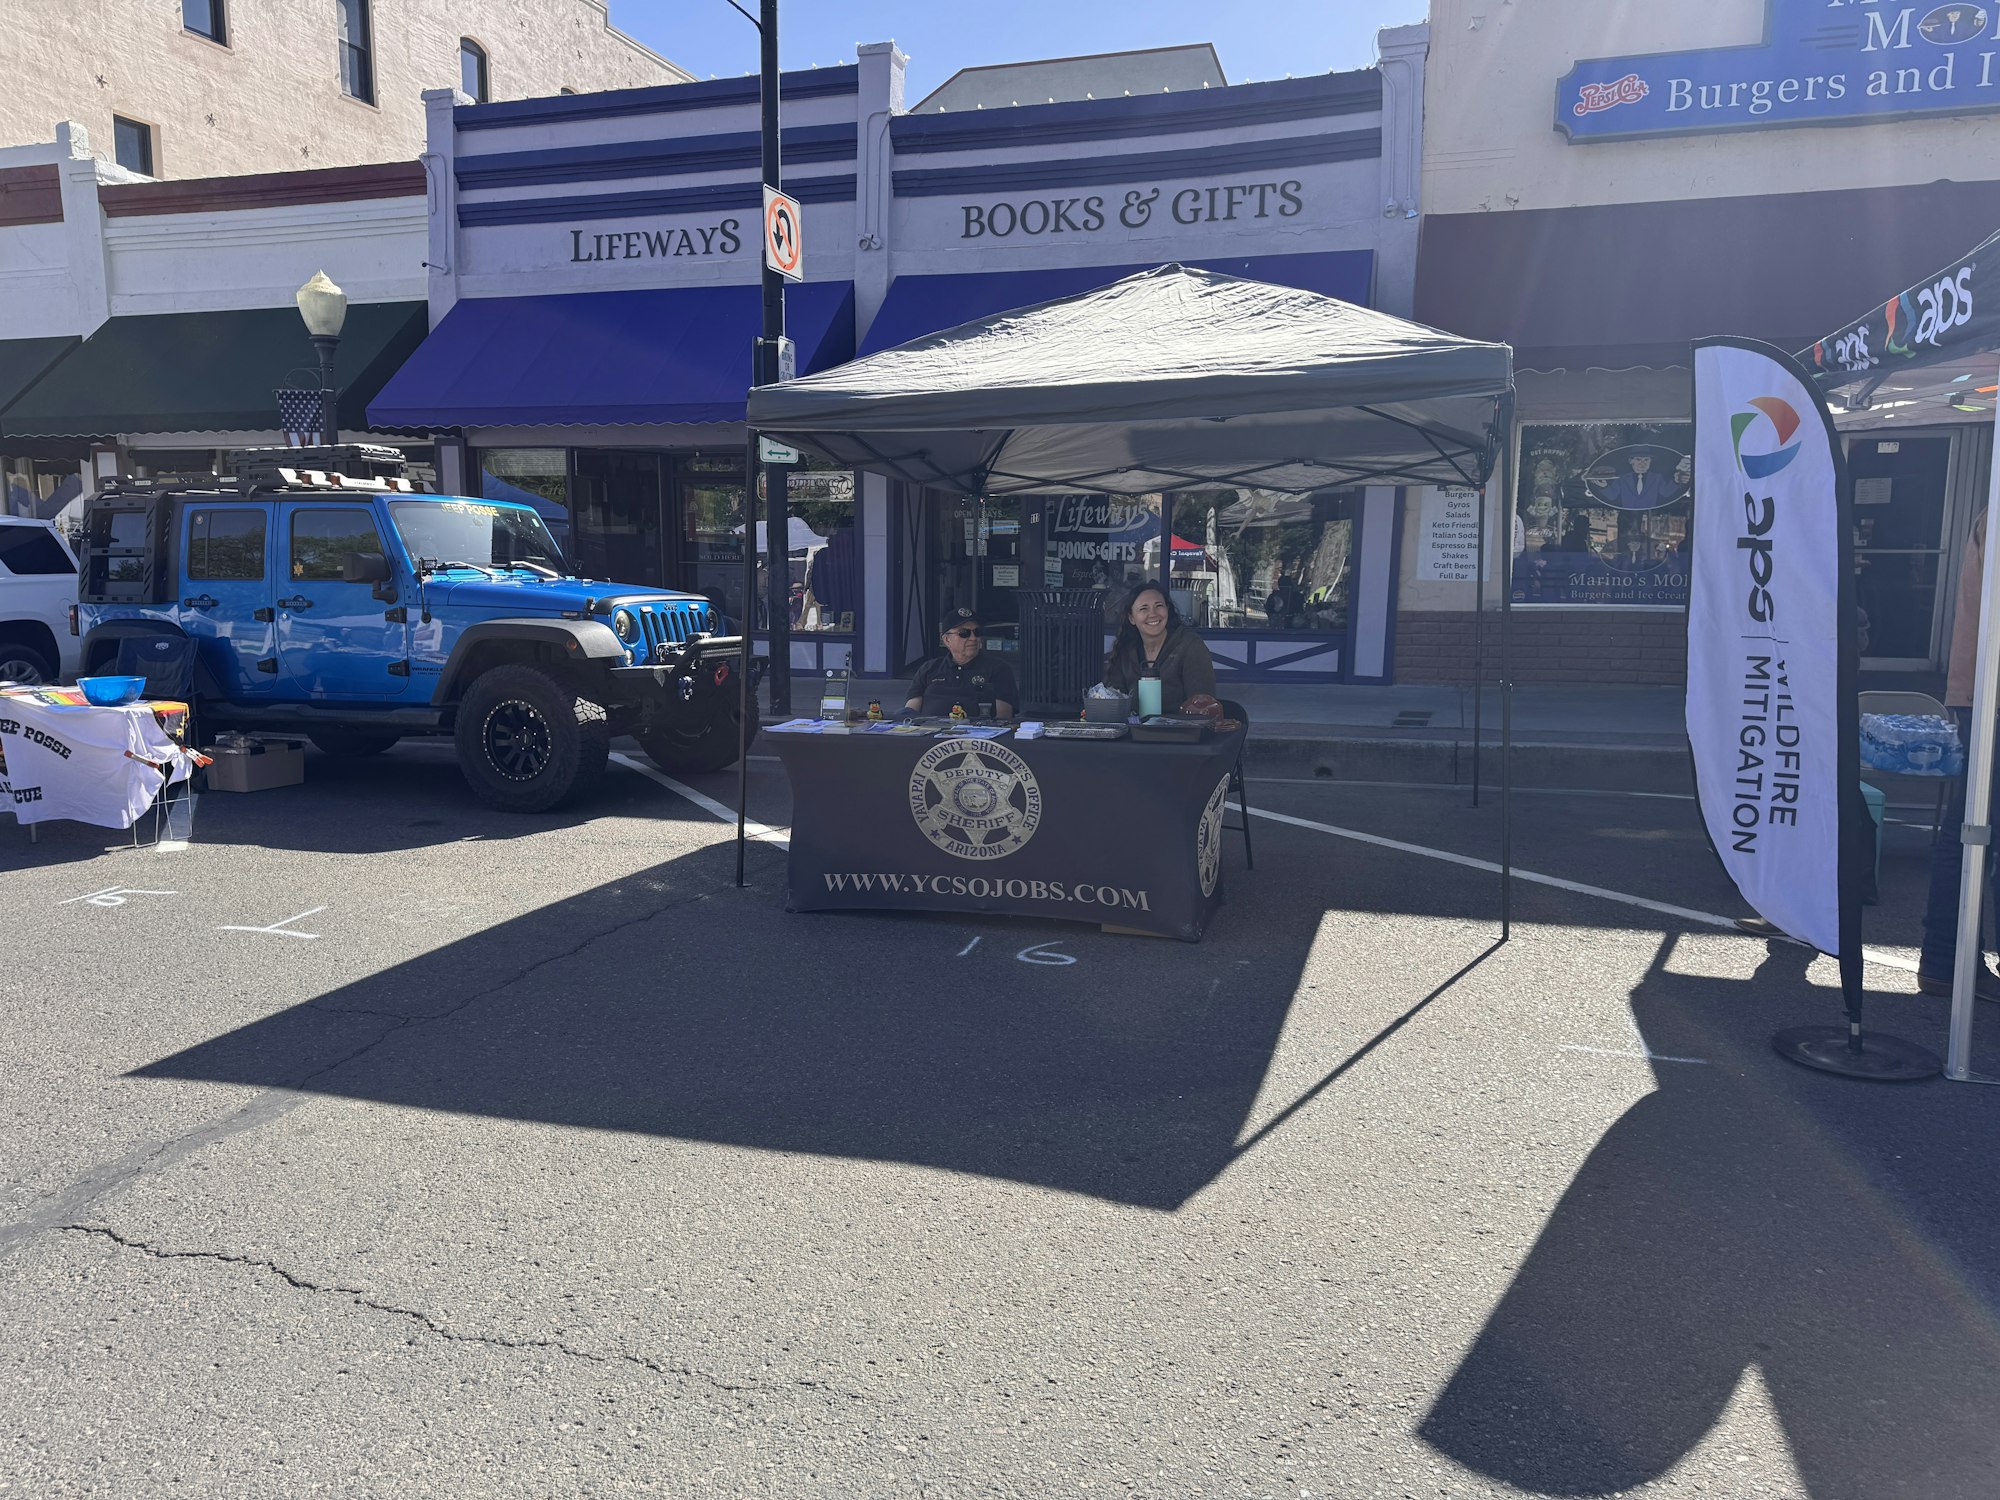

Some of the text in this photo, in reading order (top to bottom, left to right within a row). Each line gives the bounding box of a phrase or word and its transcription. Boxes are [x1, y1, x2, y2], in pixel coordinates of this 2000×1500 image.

[1665, 72, 1847, 114] Burgers
[1866, 52, 1955, 96] and
[961, 180, 1303, 239] BOOKS & GIFTS
[570, 219, 741, 262] LIFEWAYS
[1445, 491, 1475, 499] Burgers
[440, 502, 500, 517] JEEP POSSE
[1054, 494, 1150, 533] Lifeways
[1447, 501, 1470, 509] Gyros
[1432, 531, 1456, 539] Italian
[1432, 542, 1465, 550] Espresso
[1737, 491, 1775, 623] aps
[1568, 572, 1647, 587] Marino's
[1571, 590, 1612, 599] Burgers
[1614, 590, 1634, 599] and
[1638, 590, 1654, 599] Ice
[23, 726, 72, 760] POSSE
[1731, 655, 1771, 854] MITIGATION
[944, 768, 1003, 780] DEPUTY
[911, 772, 929, 824] YAVAPAI
[921, 740, 965, 770] COUNTY
[971, 740, 1032, 782] SHERIFF'S
[1022, 786, 1040, 832] OFFICE
[937, 810, 1015, 829] SHERIFF
[944, 843, 1007, 857] ARIZONA
[823, 873, 1152, 912] WWW.YCSOJOBS.COM
